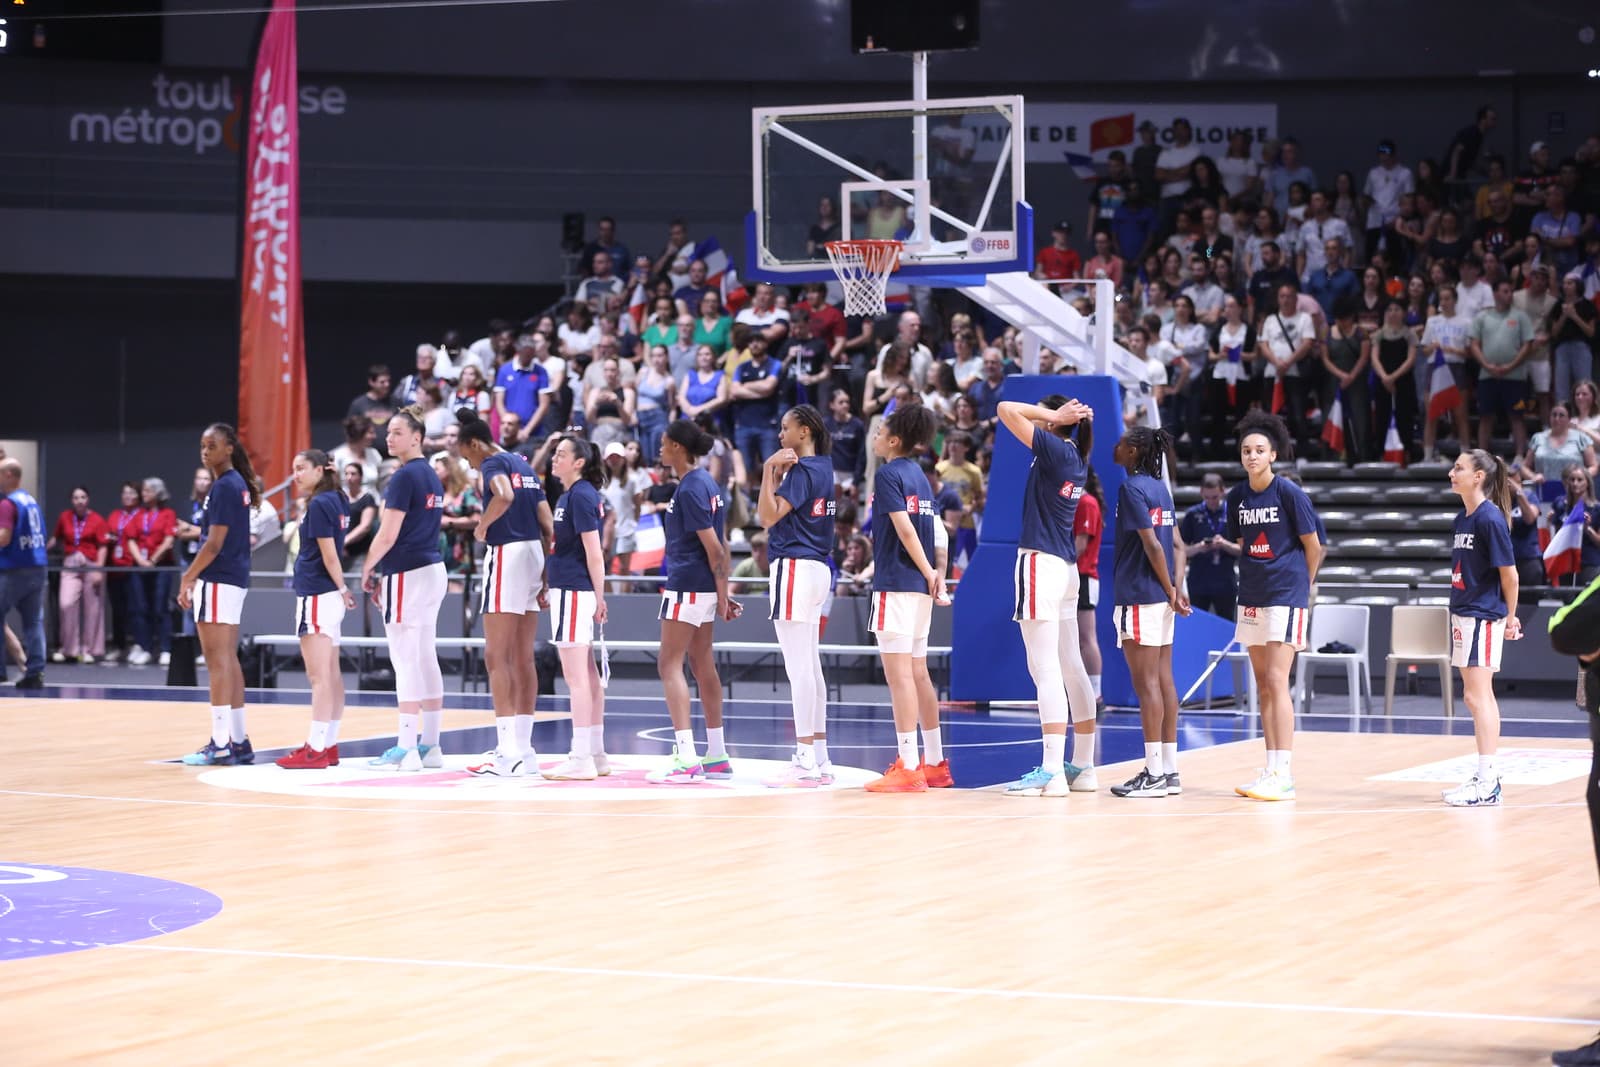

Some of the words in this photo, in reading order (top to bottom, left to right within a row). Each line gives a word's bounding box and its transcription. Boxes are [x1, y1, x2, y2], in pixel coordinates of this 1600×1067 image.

[153, 73, 348, 116] toulse
[1049, 126, 1077, 143] DE
[987, 239, 1010, 250] FFBB
[1239, 506, 1280, 526] FRANCE
[1249, 544, 1271, 554] MAIF
